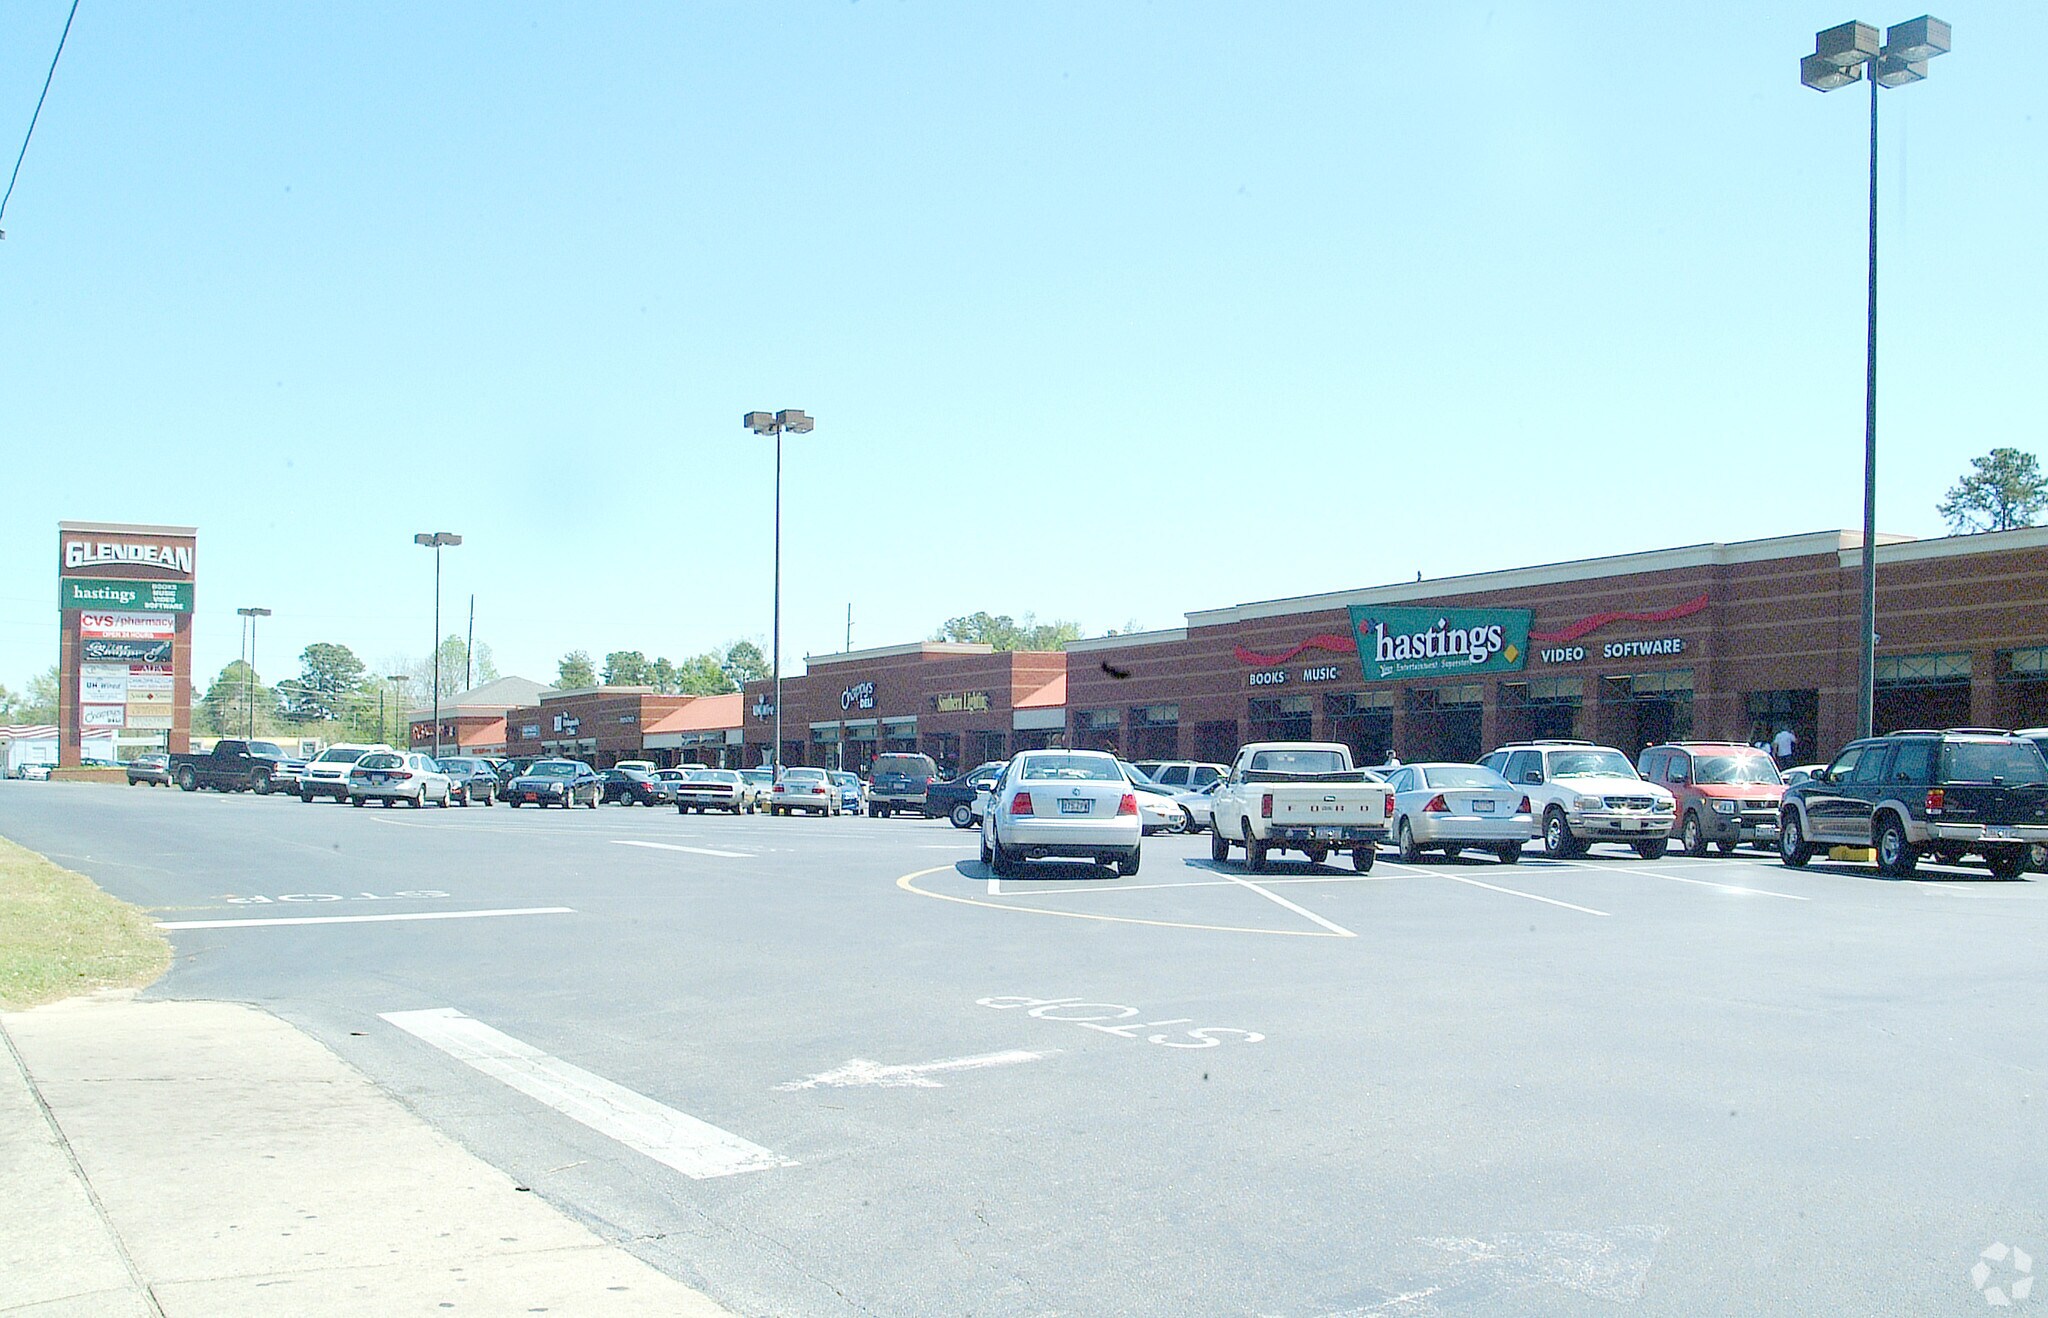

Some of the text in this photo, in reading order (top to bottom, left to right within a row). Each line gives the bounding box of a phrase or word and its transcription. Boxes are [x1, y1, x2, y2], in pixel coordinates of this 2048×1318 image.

[66, 541, 192, 574] GLENDEAN
[74, 585, 136, 604] hastings
[1375, 617, 1503, 663] hastings
[1541, 638, 1681, 663] VIDEO SOFTWARE
[1249, 667, 1337, 685] BOOKS MUSIC
[860, 697, 873, 709] DELI
[976, 996, 1265, 1048] STOP
